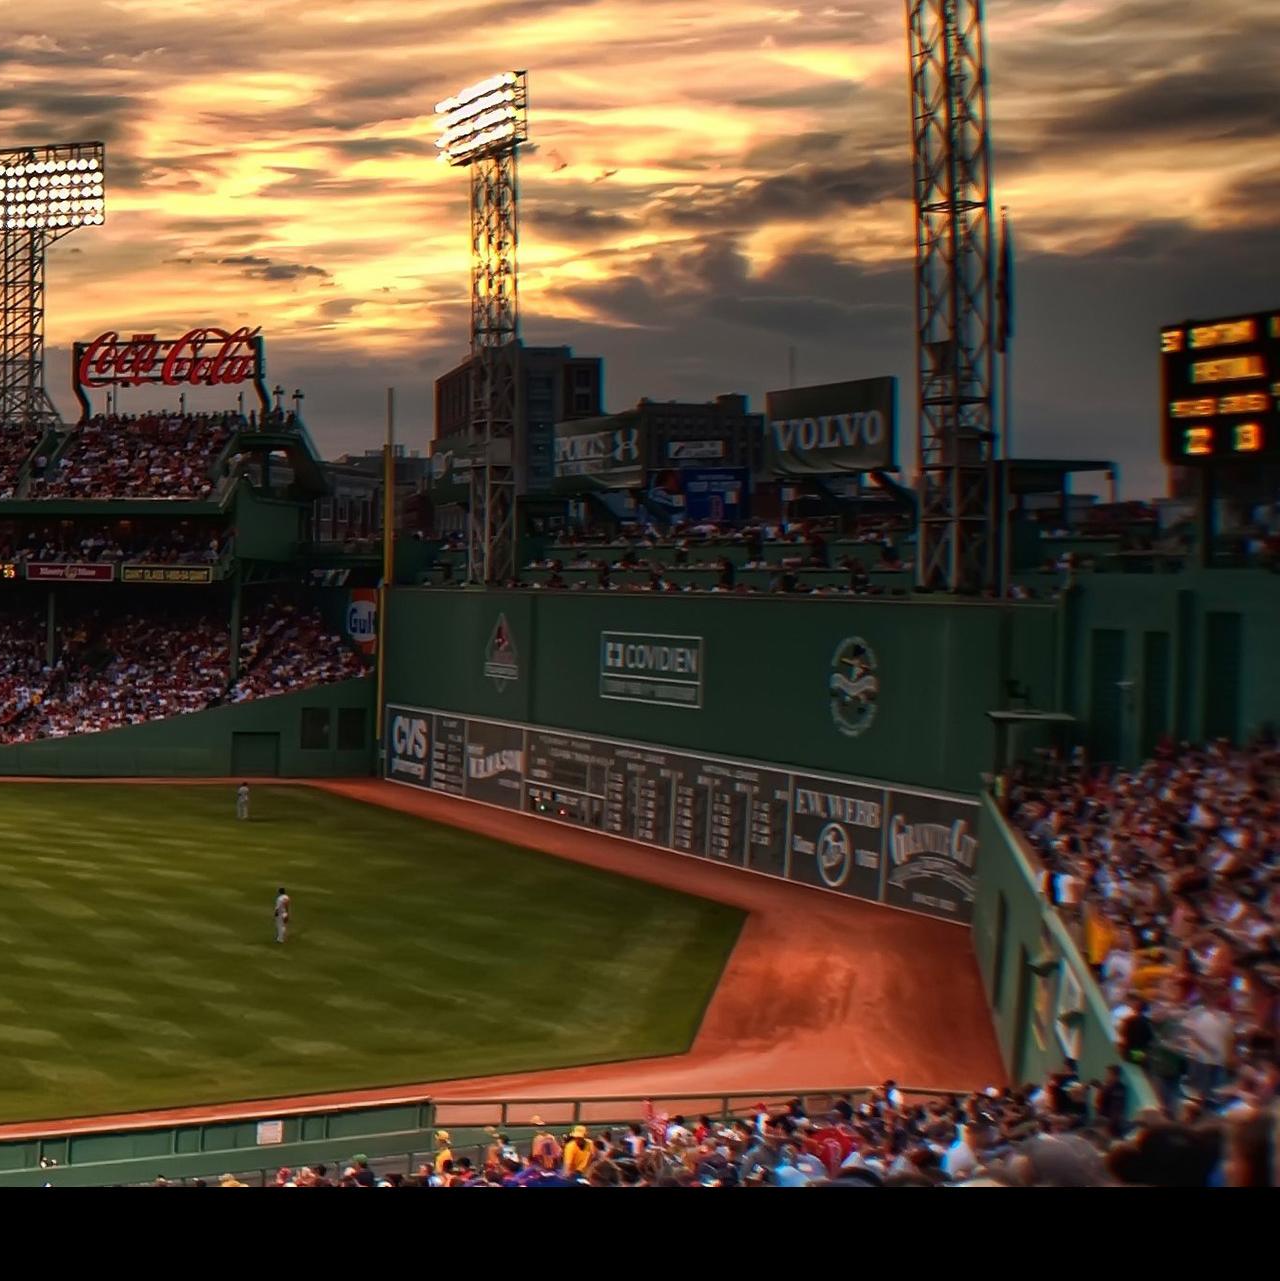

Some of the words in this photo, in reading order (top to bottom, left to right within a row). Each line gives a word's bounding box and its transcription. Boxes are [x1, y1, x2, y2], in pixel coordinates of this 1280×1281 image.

[80, 325, 262, 388] Coca-Cola
[771, 410, 882, 451] VOLVO
[626, 643, 699, 673] COVIDIEN
[393, 715, 428, 759] CVS
